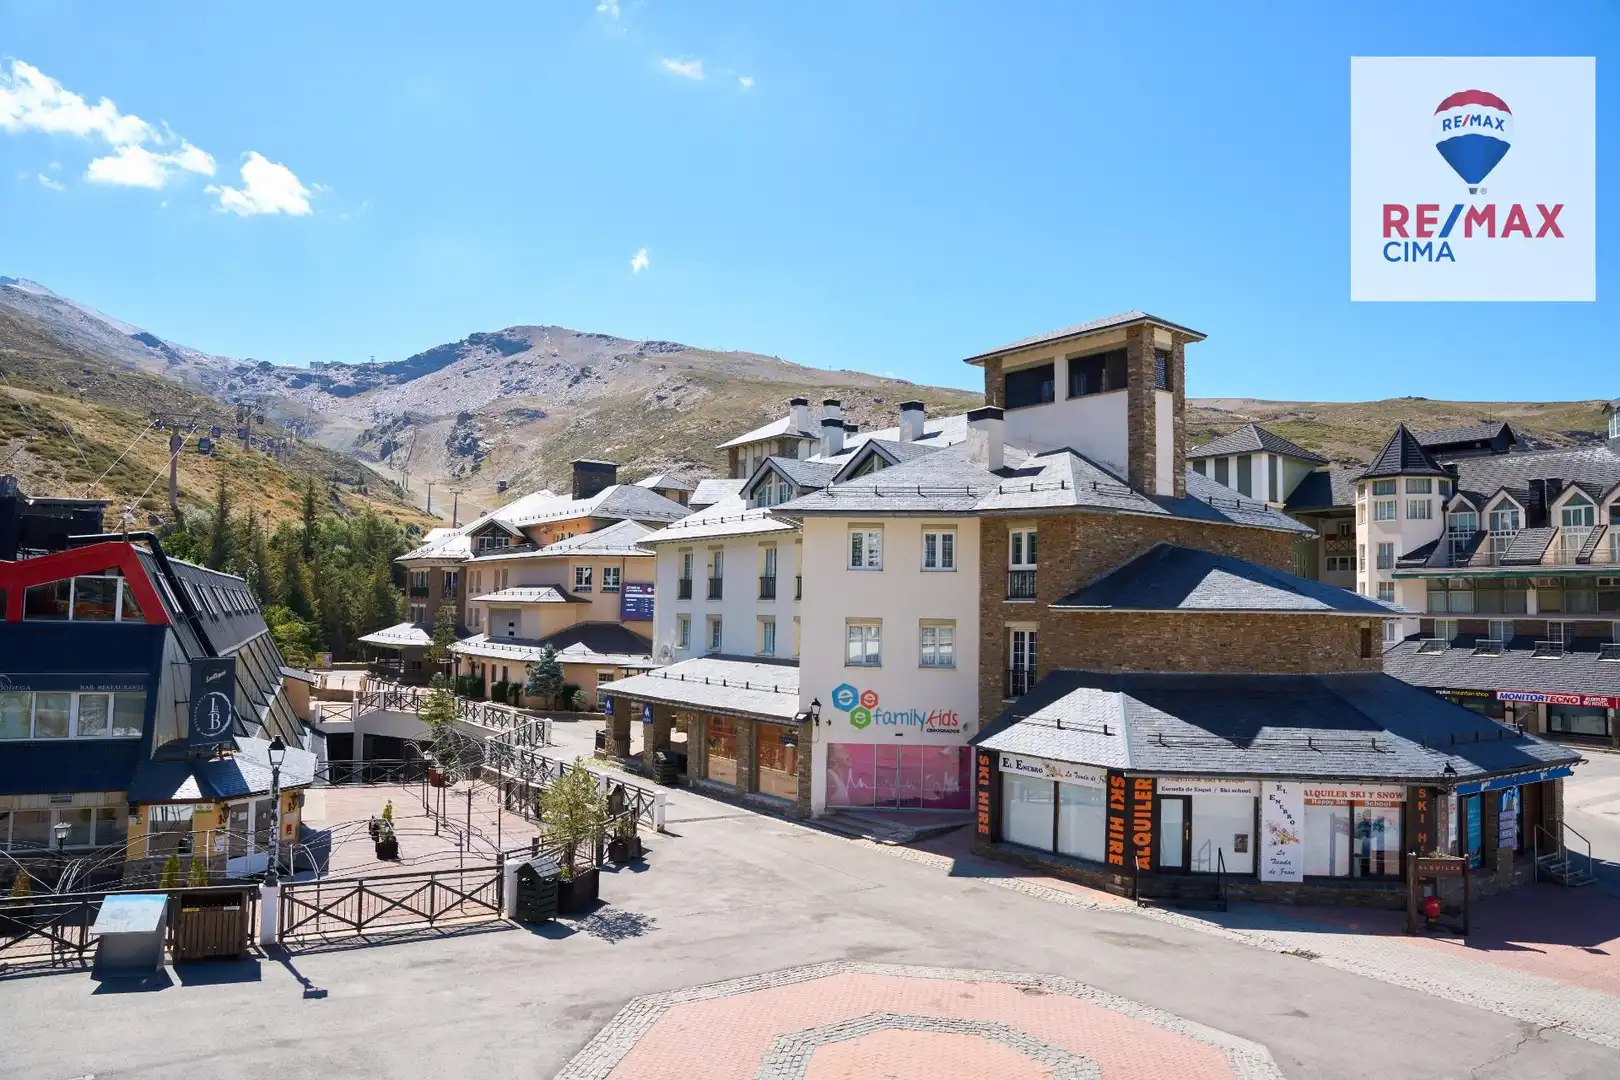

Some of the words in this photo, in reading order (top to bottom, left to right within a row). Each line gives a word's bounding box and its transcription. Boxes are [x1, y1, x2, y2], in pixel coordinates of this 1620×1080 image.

[978, 754, 990, 786] SKI
[1109, 775, 1126, 811] SKI
[1304, 789, 1348, 799] ALQUILER
[1350, 790, 1365, 799] SKI
[1368, 791, 1374, 799] Y
[1417, 788, 1427, 824] SKI
[978, 791, 989, 835] HIRE
[1132, 777, 1152, 871] ALQUILER
[1108, 816, 1125, 866] HIRE
